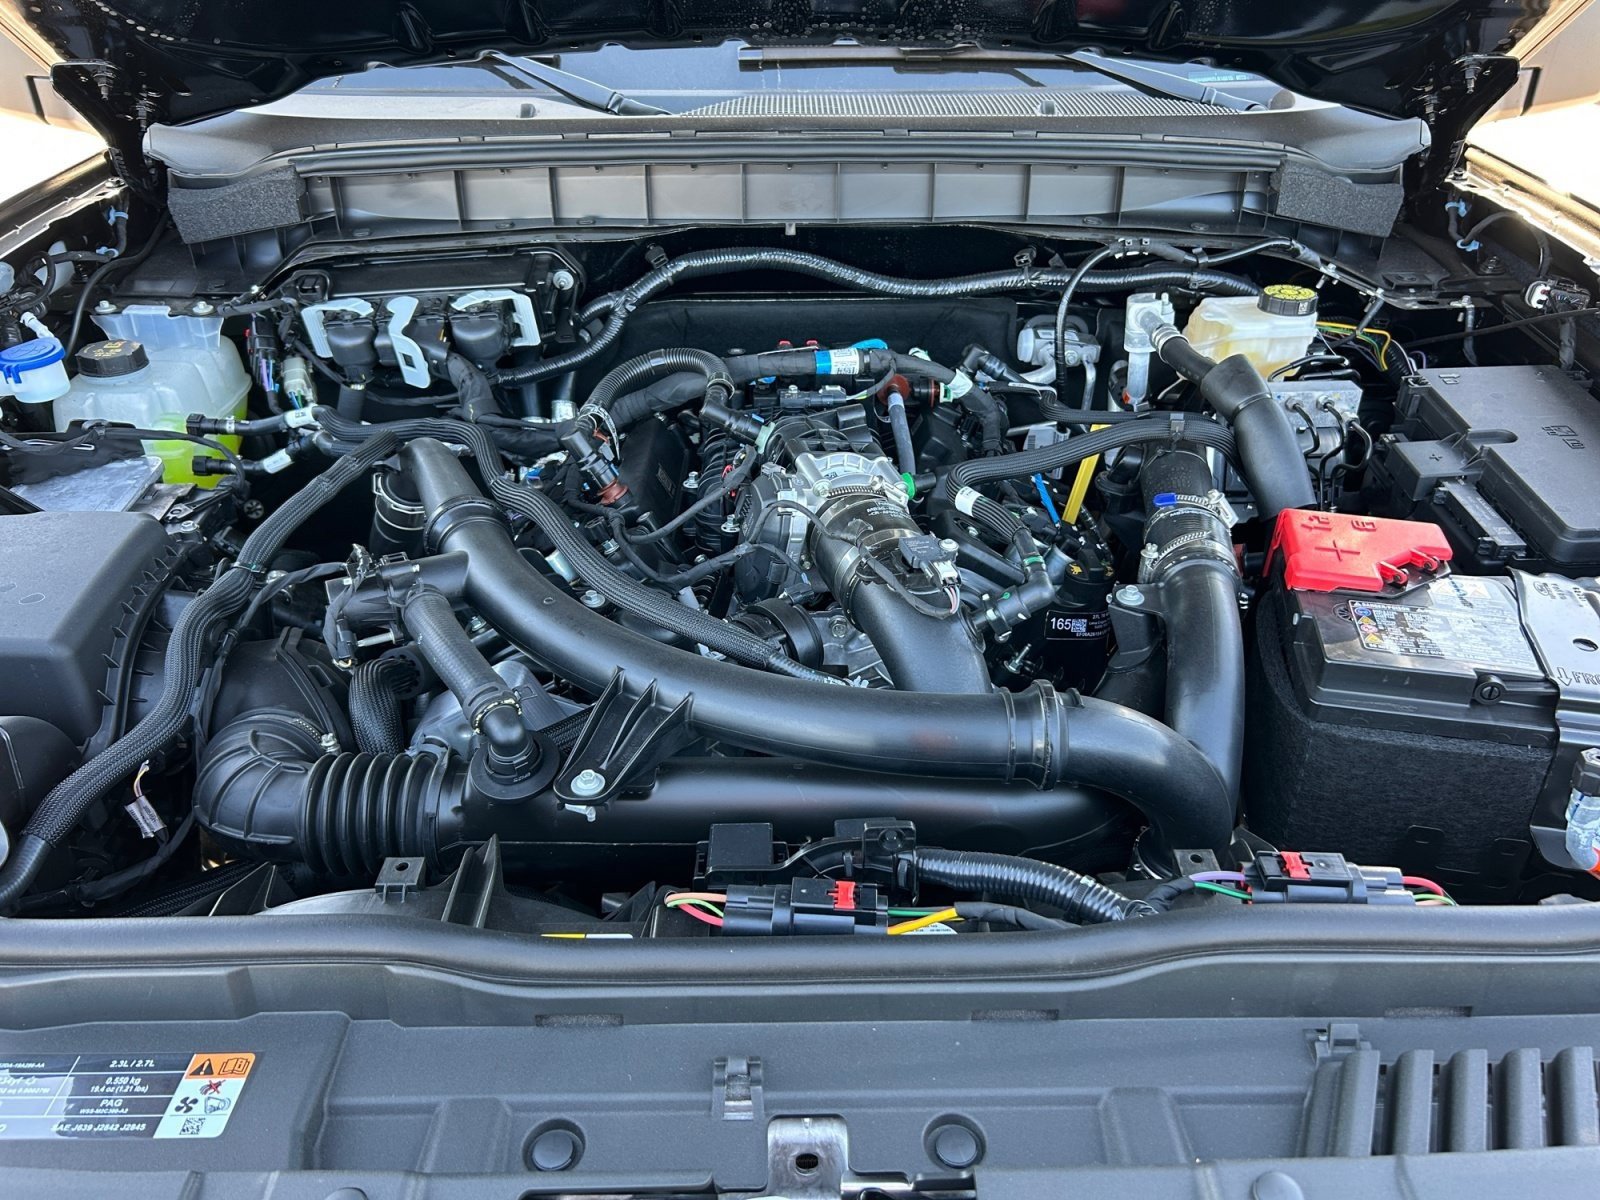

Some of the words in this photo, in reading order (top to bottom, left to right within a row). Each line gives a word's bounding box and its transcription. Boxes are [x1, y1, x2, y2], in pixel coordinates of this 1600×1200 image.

[1050, 617, 1072, 630] 165
[109, 1060, 129, 1068] 2.3L
[135, 1059, 155, 1068] 2.7L
[105, 1077, 129, 1085] 0.550
[129, 1076, 142, 1086] kg
[100, 1099, 124, 1107] PAG
[71, 1124, 94, 1132] J639
